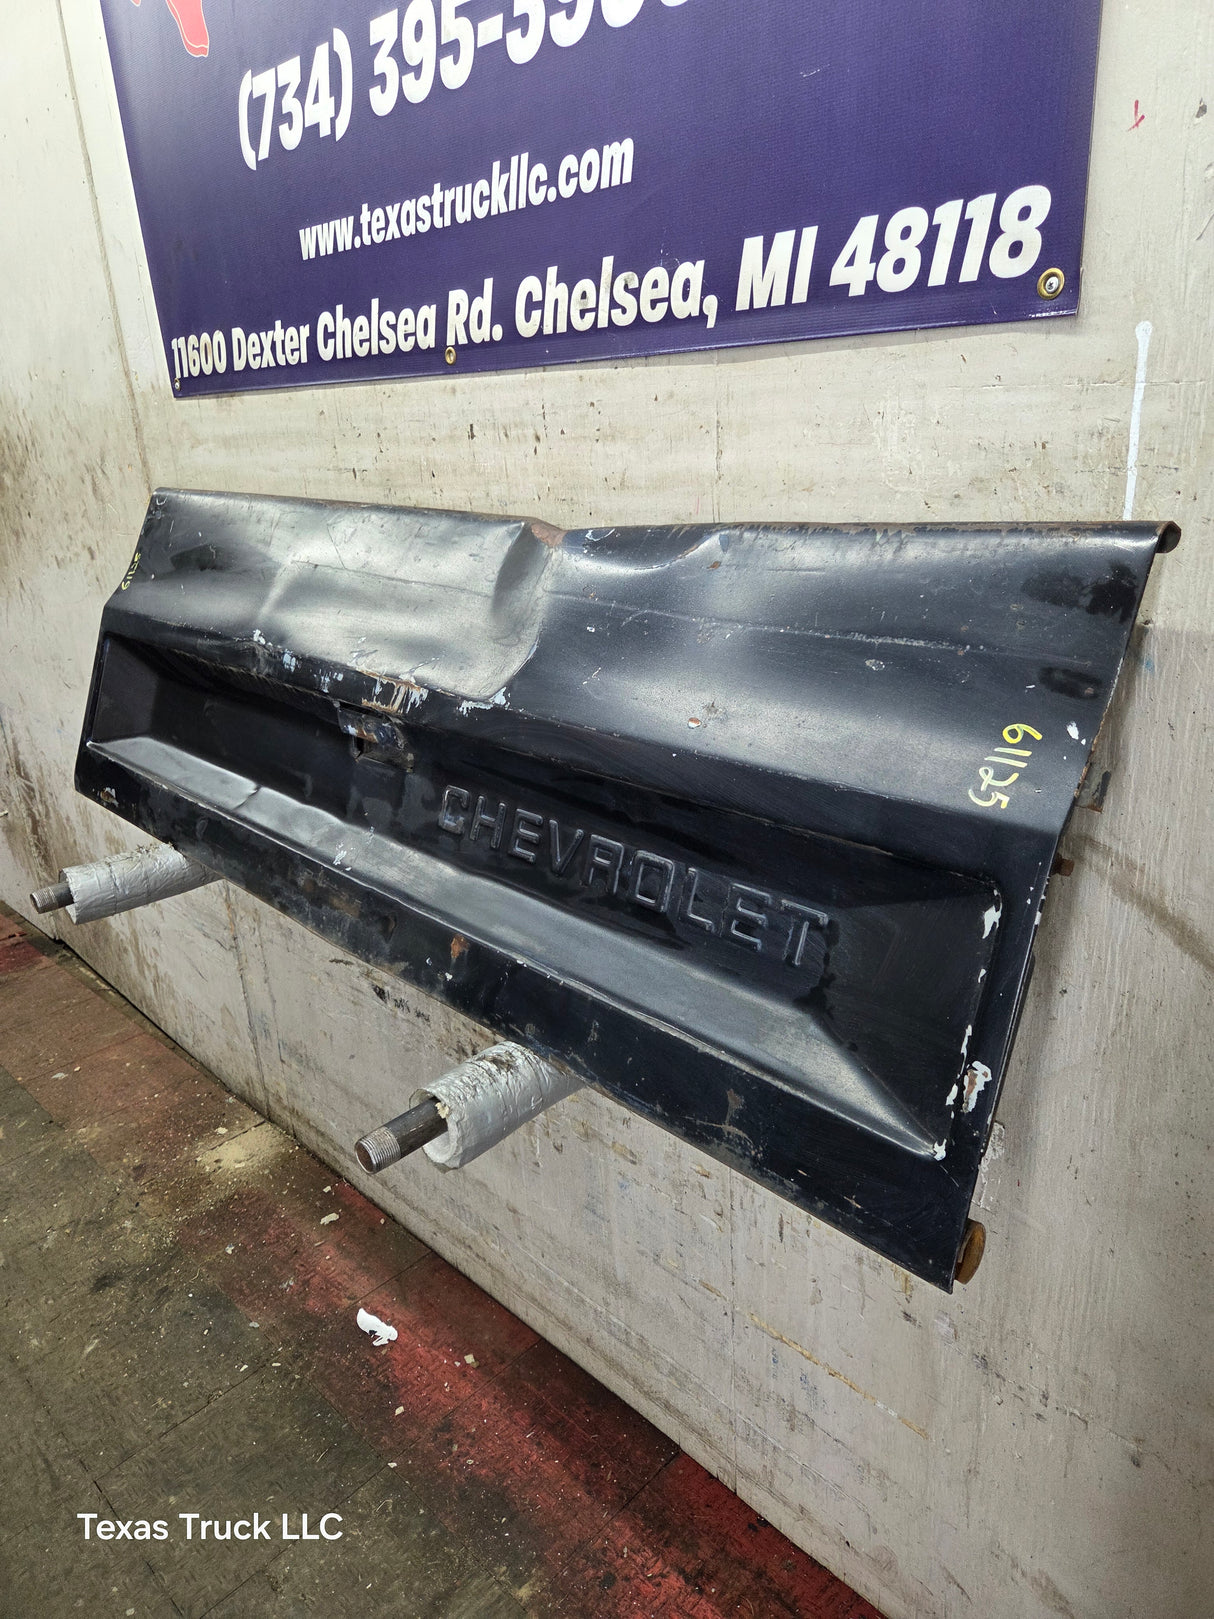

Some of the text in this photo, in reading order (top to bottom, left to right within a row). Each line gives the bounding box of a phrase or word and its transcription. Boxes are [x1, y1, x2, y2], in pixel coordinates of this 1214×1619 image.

[238, 28, 353, 170] (734)
[299, 137, 634, 260] www.texastruckllc.com
[171, 185, 1052, 379] 11600 Dexter Chelsea Rd. Chelsea, MI 48118
[968, 723, 1043, 809] 61125
[437, 784, 830, 967] CHEVROLET
